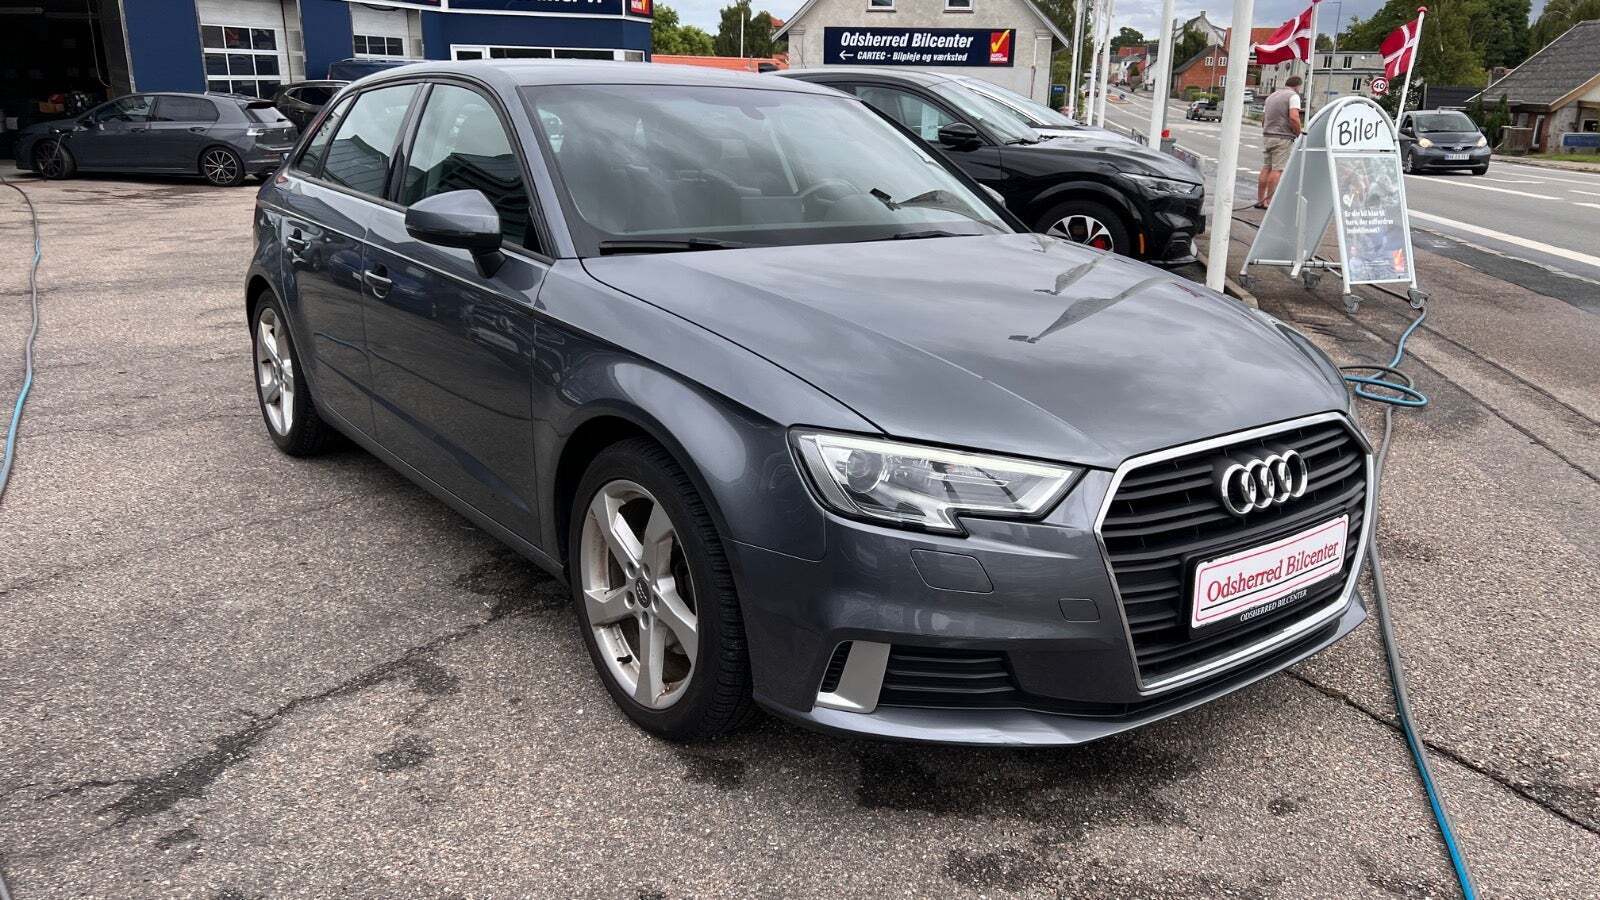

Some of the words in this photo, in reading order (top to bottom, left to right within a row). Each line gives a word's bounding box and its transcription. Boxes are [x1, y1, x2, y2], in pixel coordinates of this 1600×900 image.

[840, 31, 909, 47] Odsherred
[911, 33, 974, 48] Bilcenter
[857, 51, 886, 60] CARTEC
[892, 52, 921, 62] Bilpleje
[921, 54, 932, 62] og
[933, 52, 968, 61] værksted
[1337, 118, 1383, 146] Biler
[1207, 560, 1283, 603] Odsherred
[1285, 542, 1339, 576] Bilcenter
[1240, 603, 1277, 622] ODSHERRED
[1277, 589, 1308, 608] BILCENTER
